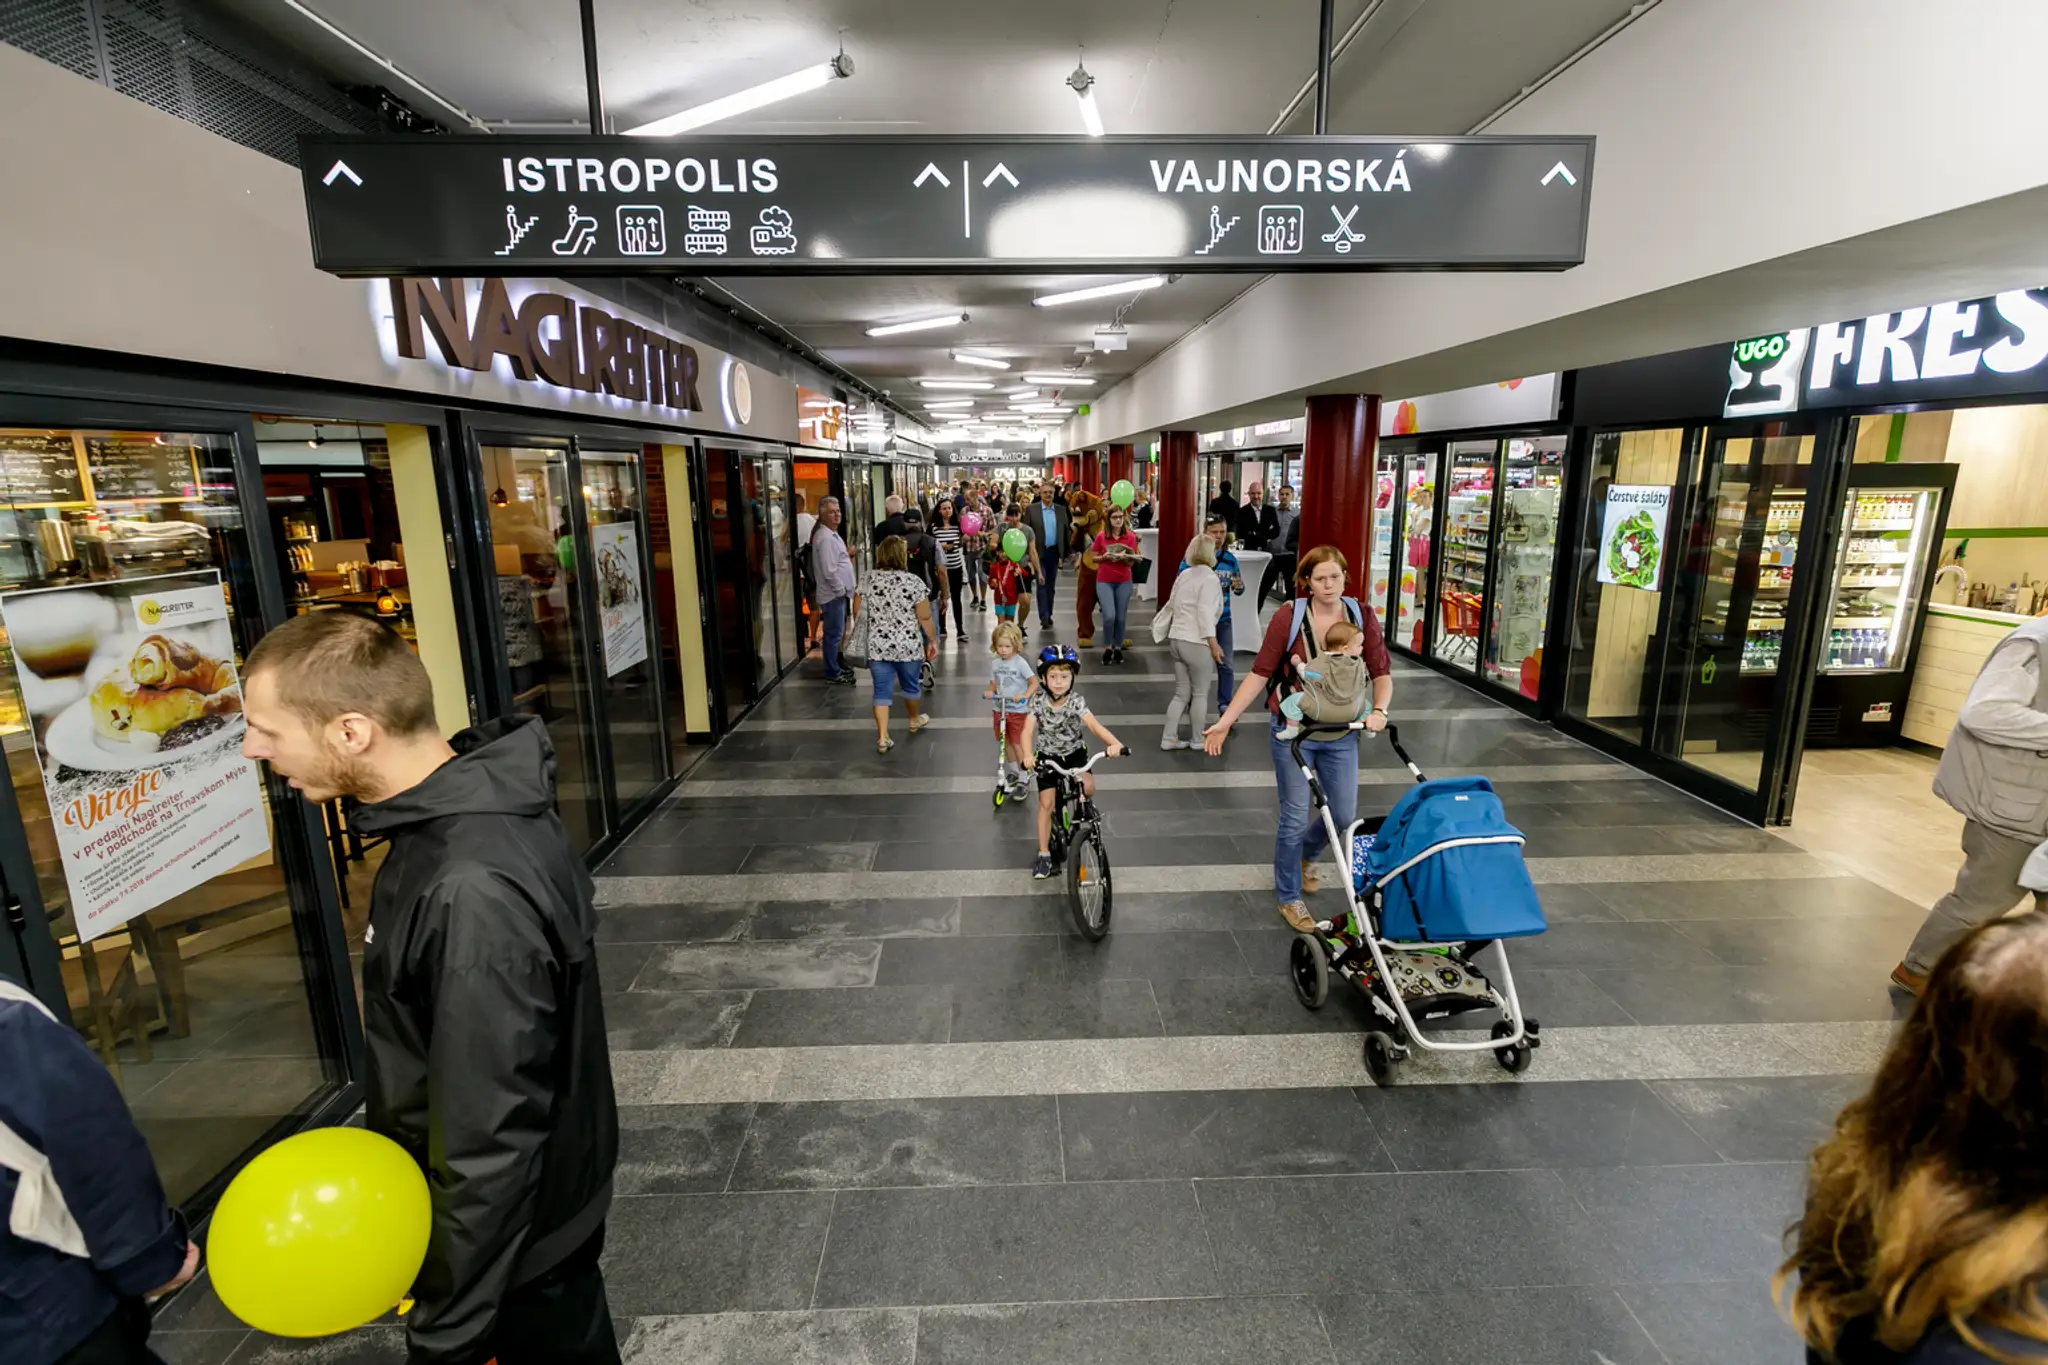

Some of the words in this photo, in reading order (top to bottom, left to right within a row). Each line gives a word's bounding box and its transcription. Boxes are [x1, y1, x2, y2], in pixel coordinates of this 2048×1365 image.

[502, 157, 779, 193] ISTROPOLIS
[1149, 148, 1412, 193] VAJNORSKÁ
[389, 277, 702, 411] NAGLREITER
[1738, 336, 1784, 361] UGO
[1608, 487, 1639, 503] Čerstvé
[147, 601, 195, 616] NAGLREITER
[64, 769, 163, 831] Vitajte
[96, 850, 103, 859] v
[106, 819, 158, 857] podchode
[160, 810, 173, 823] na
[173, 778, 225, 813] Trnavskom
[225, 765, 247, 783] Mýte
[73, 850, 80, 860] v
[83, 820, 131, 857] predajni
[131, 789, 185, 826] Naglreiter
